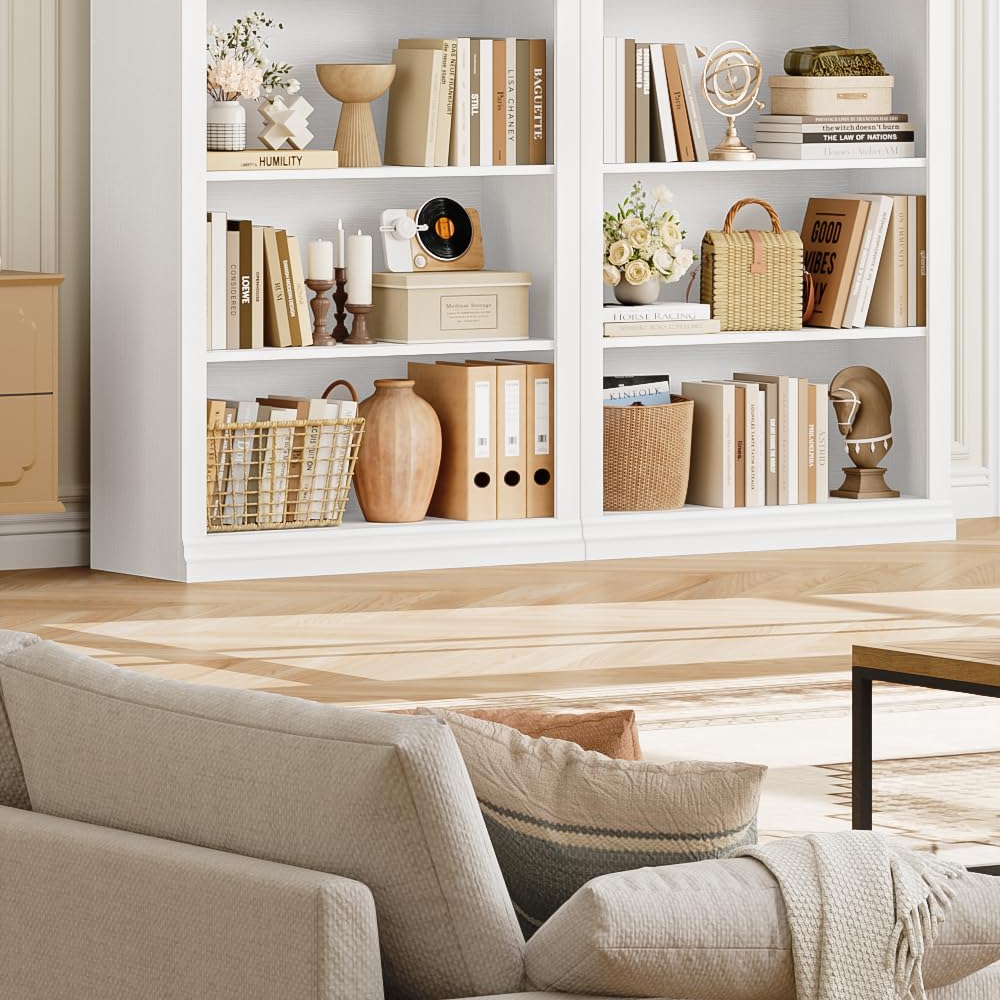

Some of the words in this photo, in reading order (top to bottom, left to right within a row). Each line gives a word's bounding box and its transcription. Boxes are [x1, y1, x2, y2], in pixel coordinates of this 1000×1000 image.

[471, 93, 479, 117] STILL
[533, 67, 543, 140] BAGUETTE
[259, 155, 303, 167] HUMILITY
[810, 220, 842, 244] GOOD
[804, 251, 837, 275] VIBES
[242, 275, 250, 305] LOEWE
[613, 313, 651, 321] HORSE
[653, 312, 697, 320] RACING
[609, 387, 662, 401] KINFOLK
